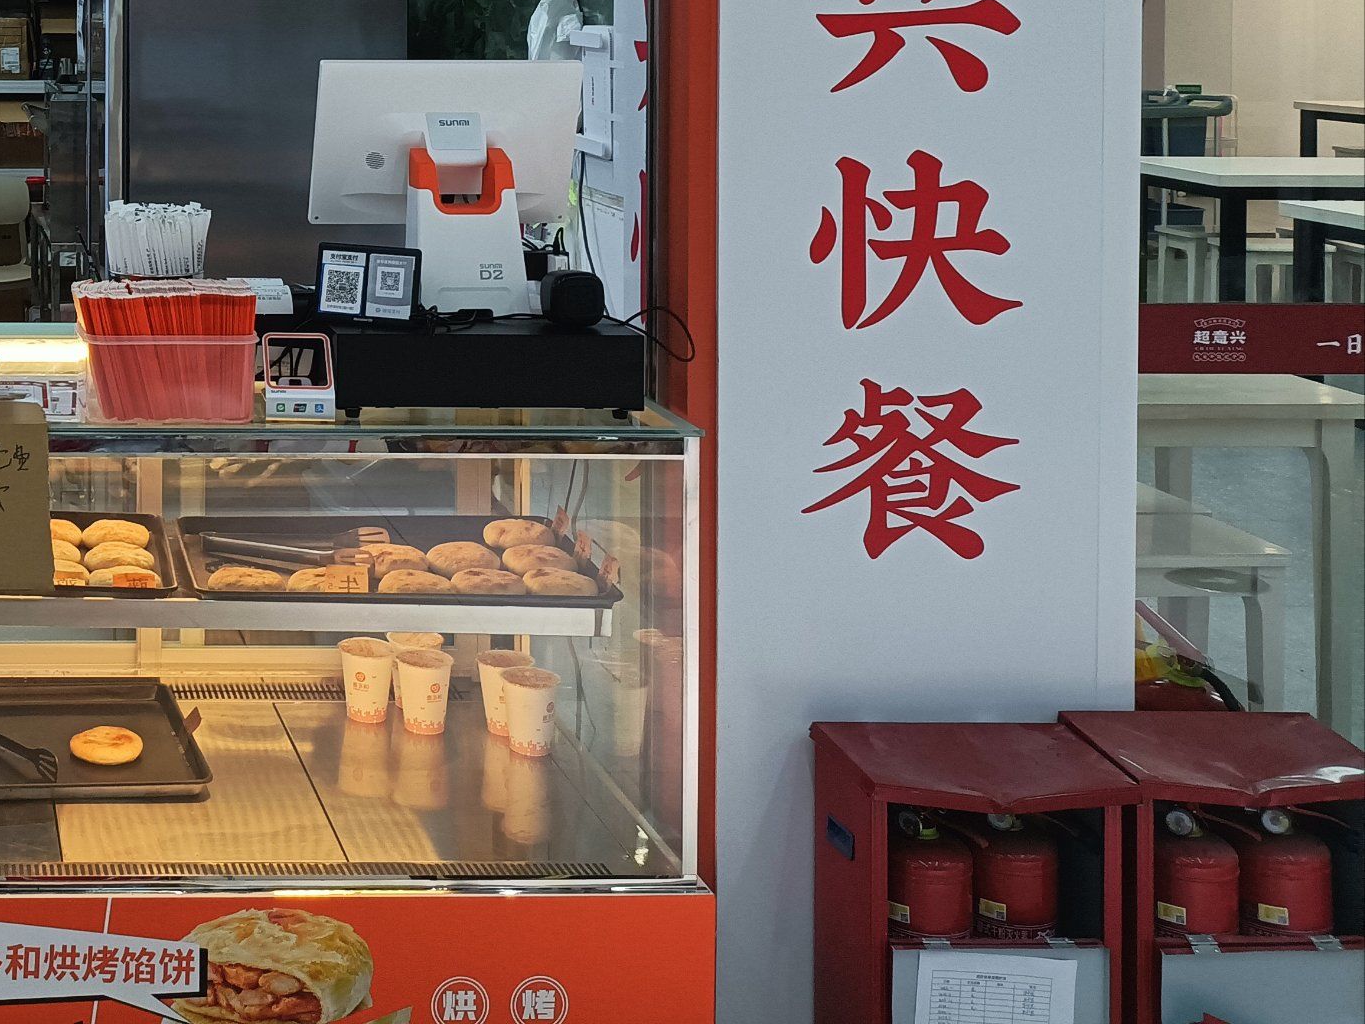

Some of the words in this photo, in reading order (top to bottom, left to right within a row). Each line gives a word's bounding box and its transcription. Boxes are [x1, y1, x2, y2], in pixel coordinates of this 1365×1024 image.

[438, 119, 470, 127] SUNMI
[480, 269, 504, 280] D2
[1192, 329, 1247, 345] 超意兴
[442, 988, 478, 1022] 烘
[521, 988, 556, 1022] 烤
